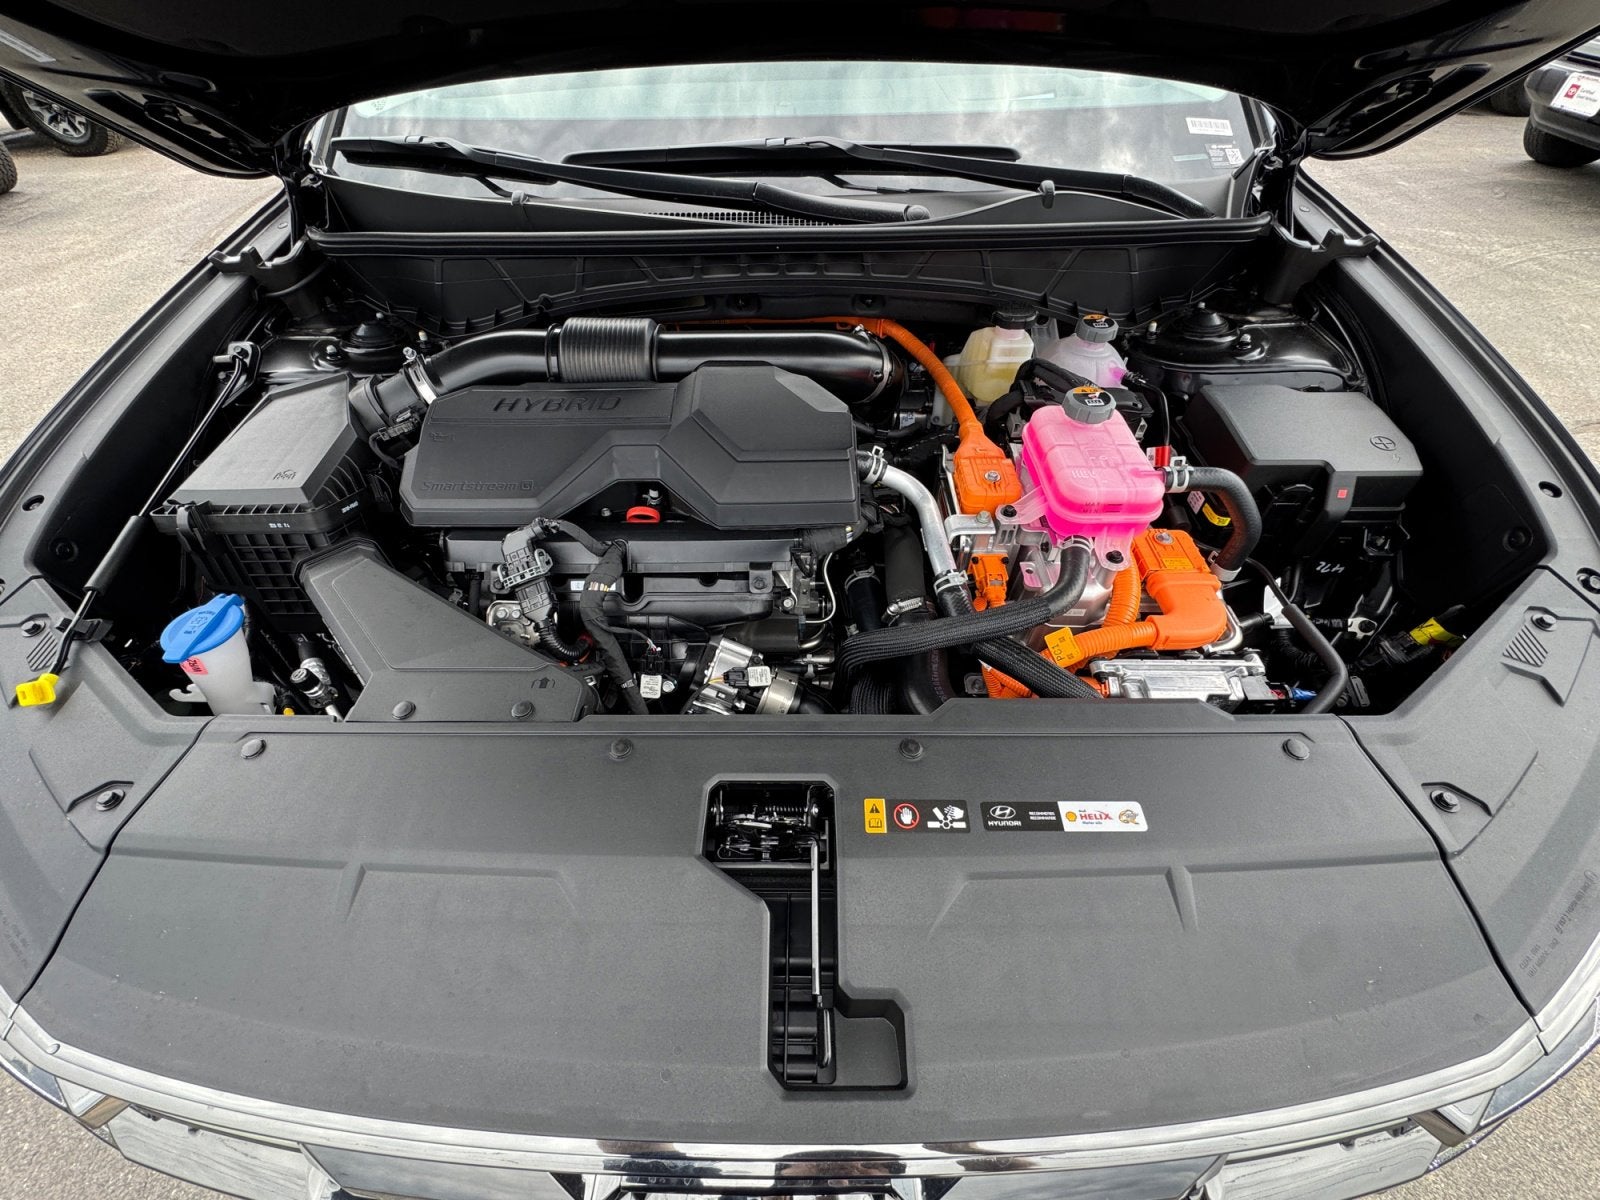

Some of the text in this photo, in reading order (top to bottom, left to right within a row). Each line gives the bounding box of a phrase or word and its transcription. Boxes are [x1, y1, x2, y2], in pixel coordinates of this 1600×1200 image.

[493, 397, 622, 413] HYBRID
[421, 480, 520, 492] Smartstream
[1080, 813, 1113, 821] HELIX
